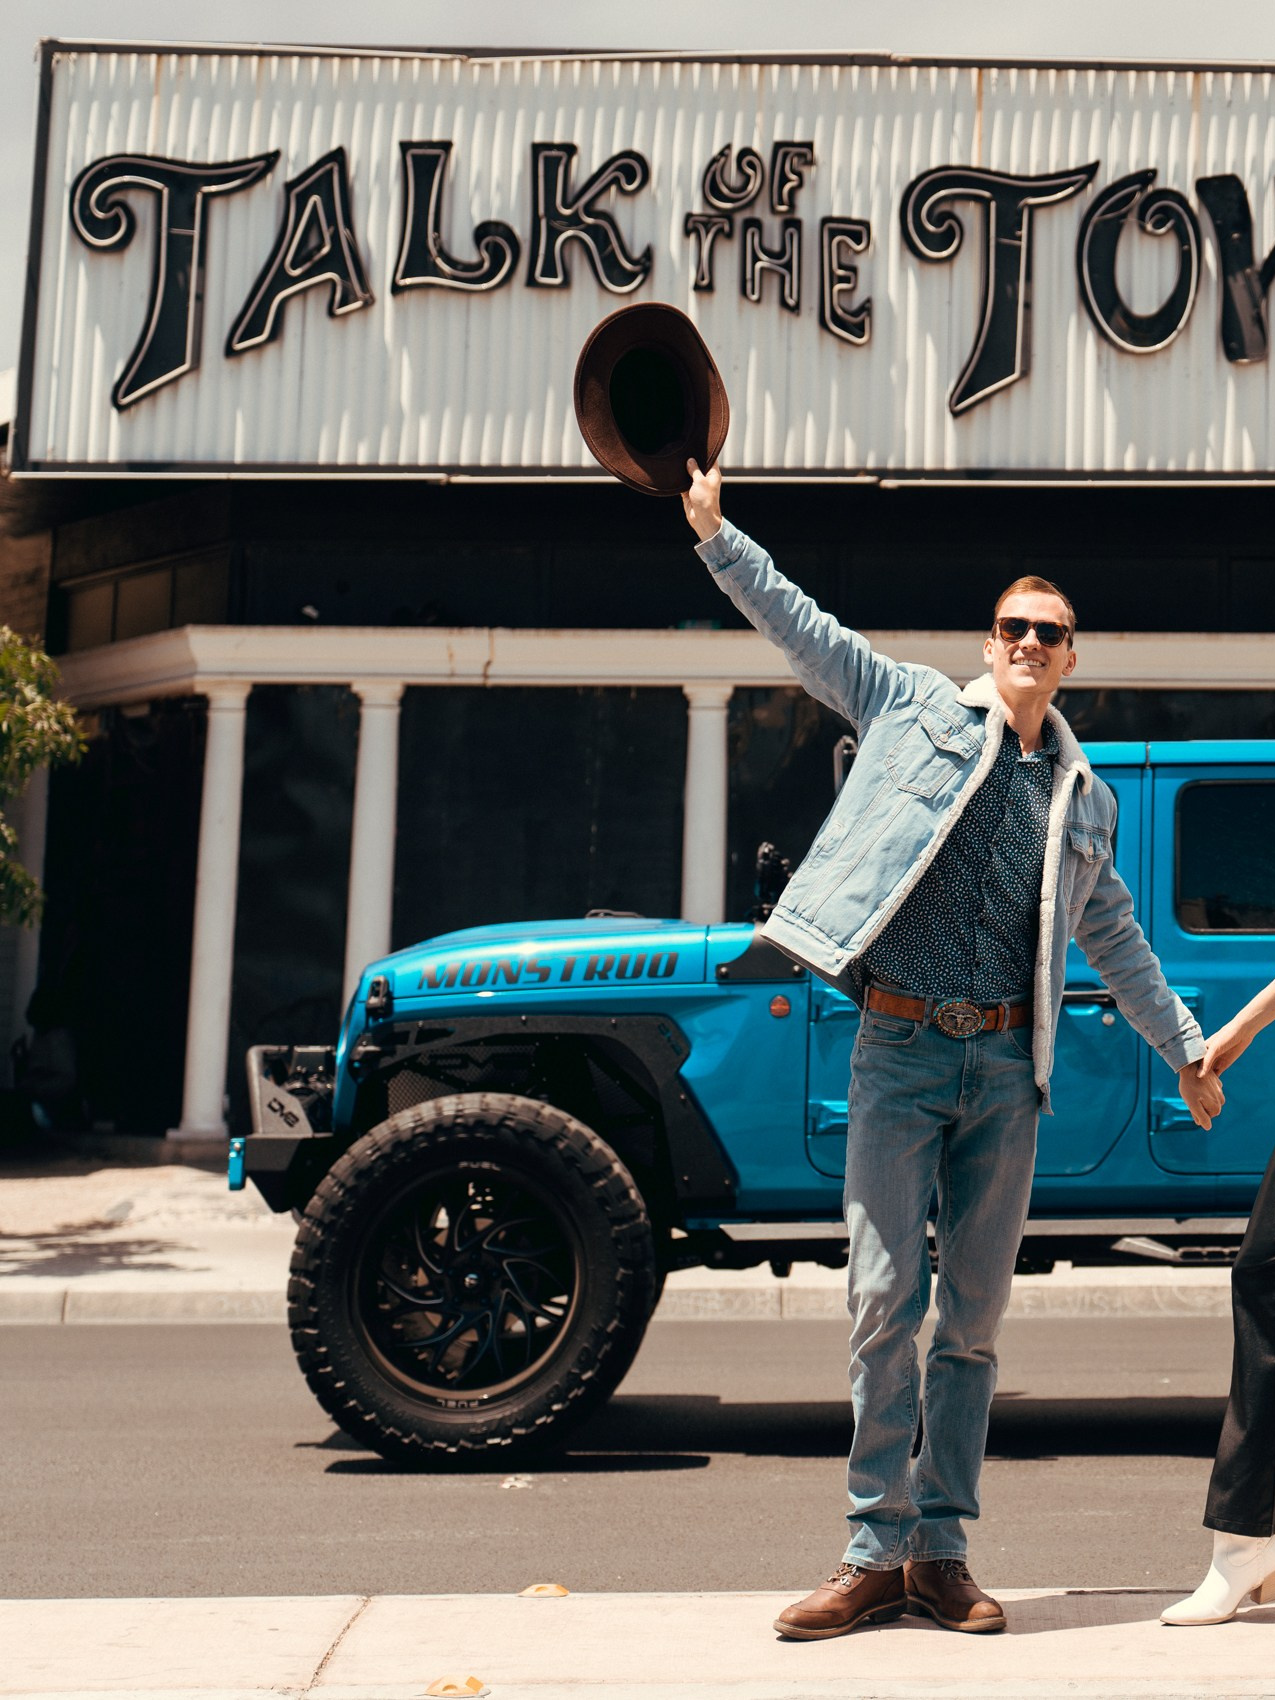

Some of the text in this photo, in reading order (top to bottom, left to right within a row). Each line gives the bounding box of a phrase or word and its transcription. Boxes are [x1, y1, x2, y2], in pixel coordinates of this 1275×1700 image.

[703, 141, 816, 214] OF
[70, 140, 654, 411] TALK
[684, 212, 872, 345] THE
[417, 952, 678, 990] MONSTRUO
[437, 1399, 479, 1408] FUEL
